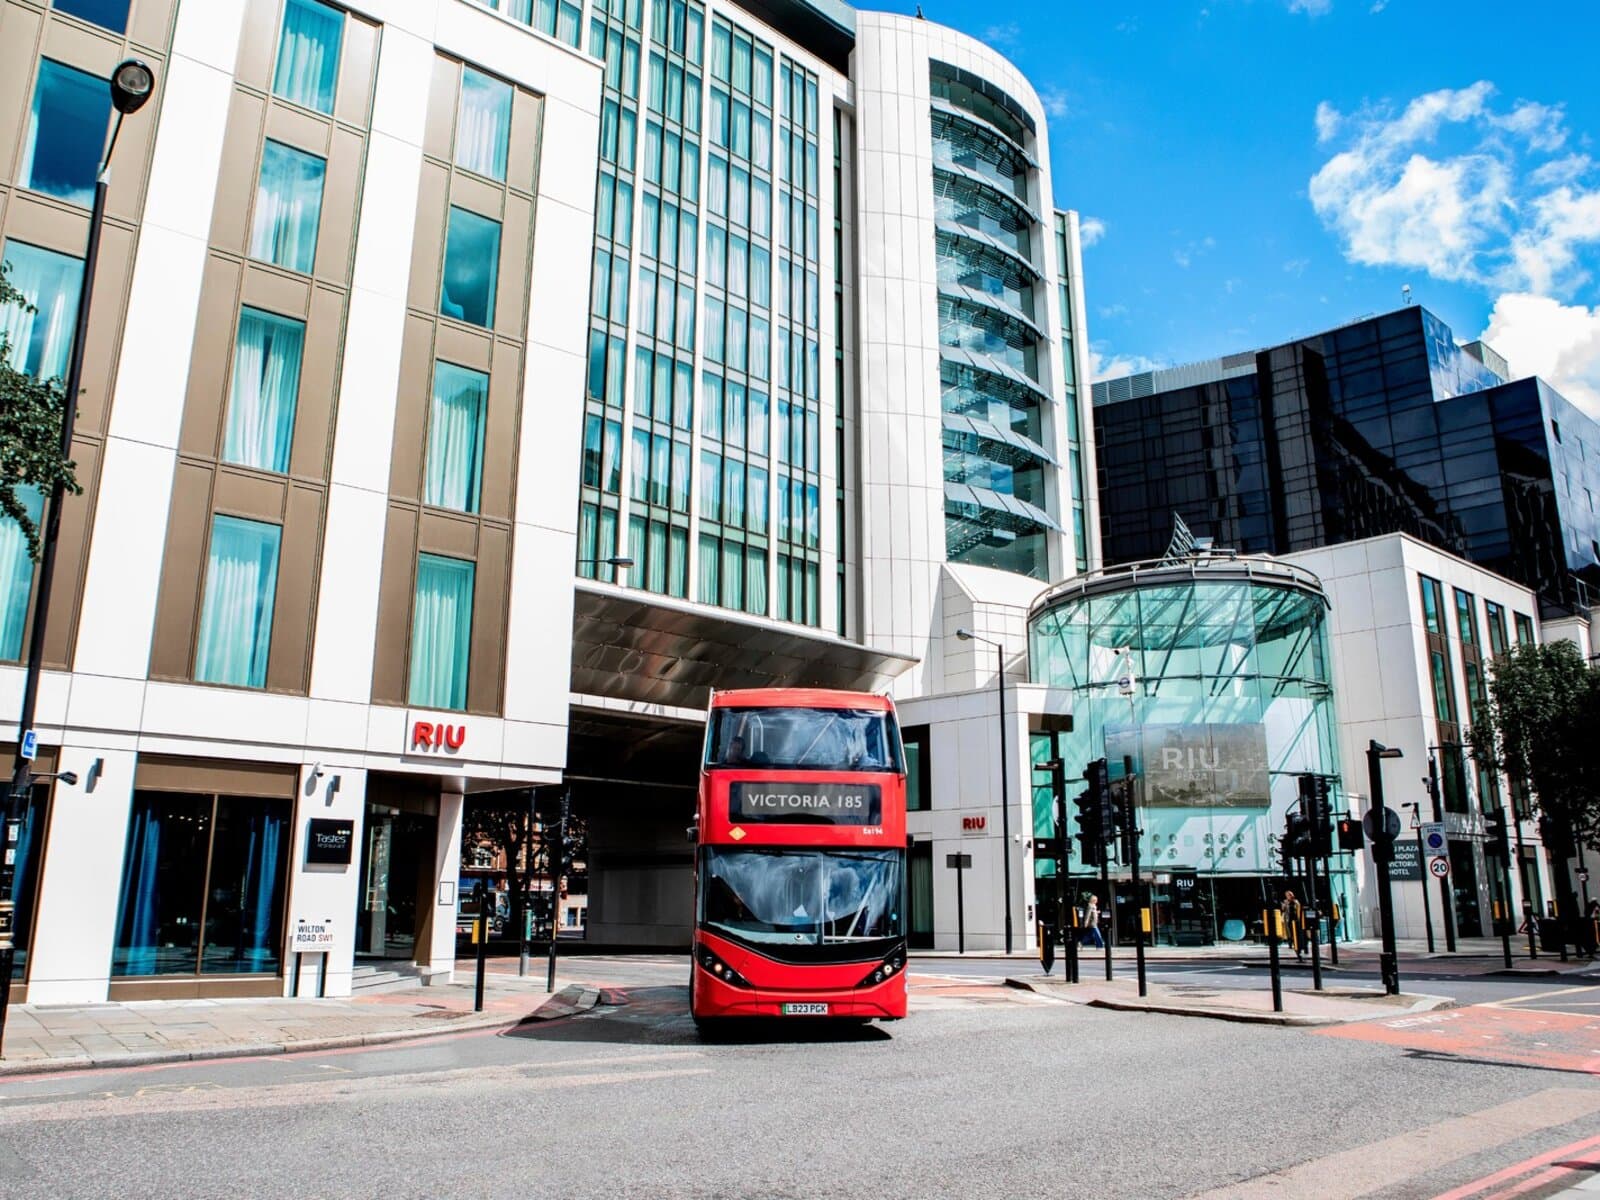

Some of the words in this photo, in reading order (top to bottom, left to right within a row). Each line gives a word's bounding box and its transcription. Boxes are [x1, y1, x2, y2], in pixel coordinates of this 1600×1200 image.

[414, 721, 466, 750] RIU
[1161, 747, 1220, 770] RIU
[748, 793, 831, 809] VICTORIA
[837, 794, 863, 809] 185
[962, 816, 986, 830] RIU
[316, 832, 347, 844] Tastes
[1433, 863, 1447, 872] 20
[1176, 879, 1195, 888] RIU
[297, 925, 326, 933] WILTON
[296, 934, 317, 943] ROAD
[318, 934, 333, 943] SW1
